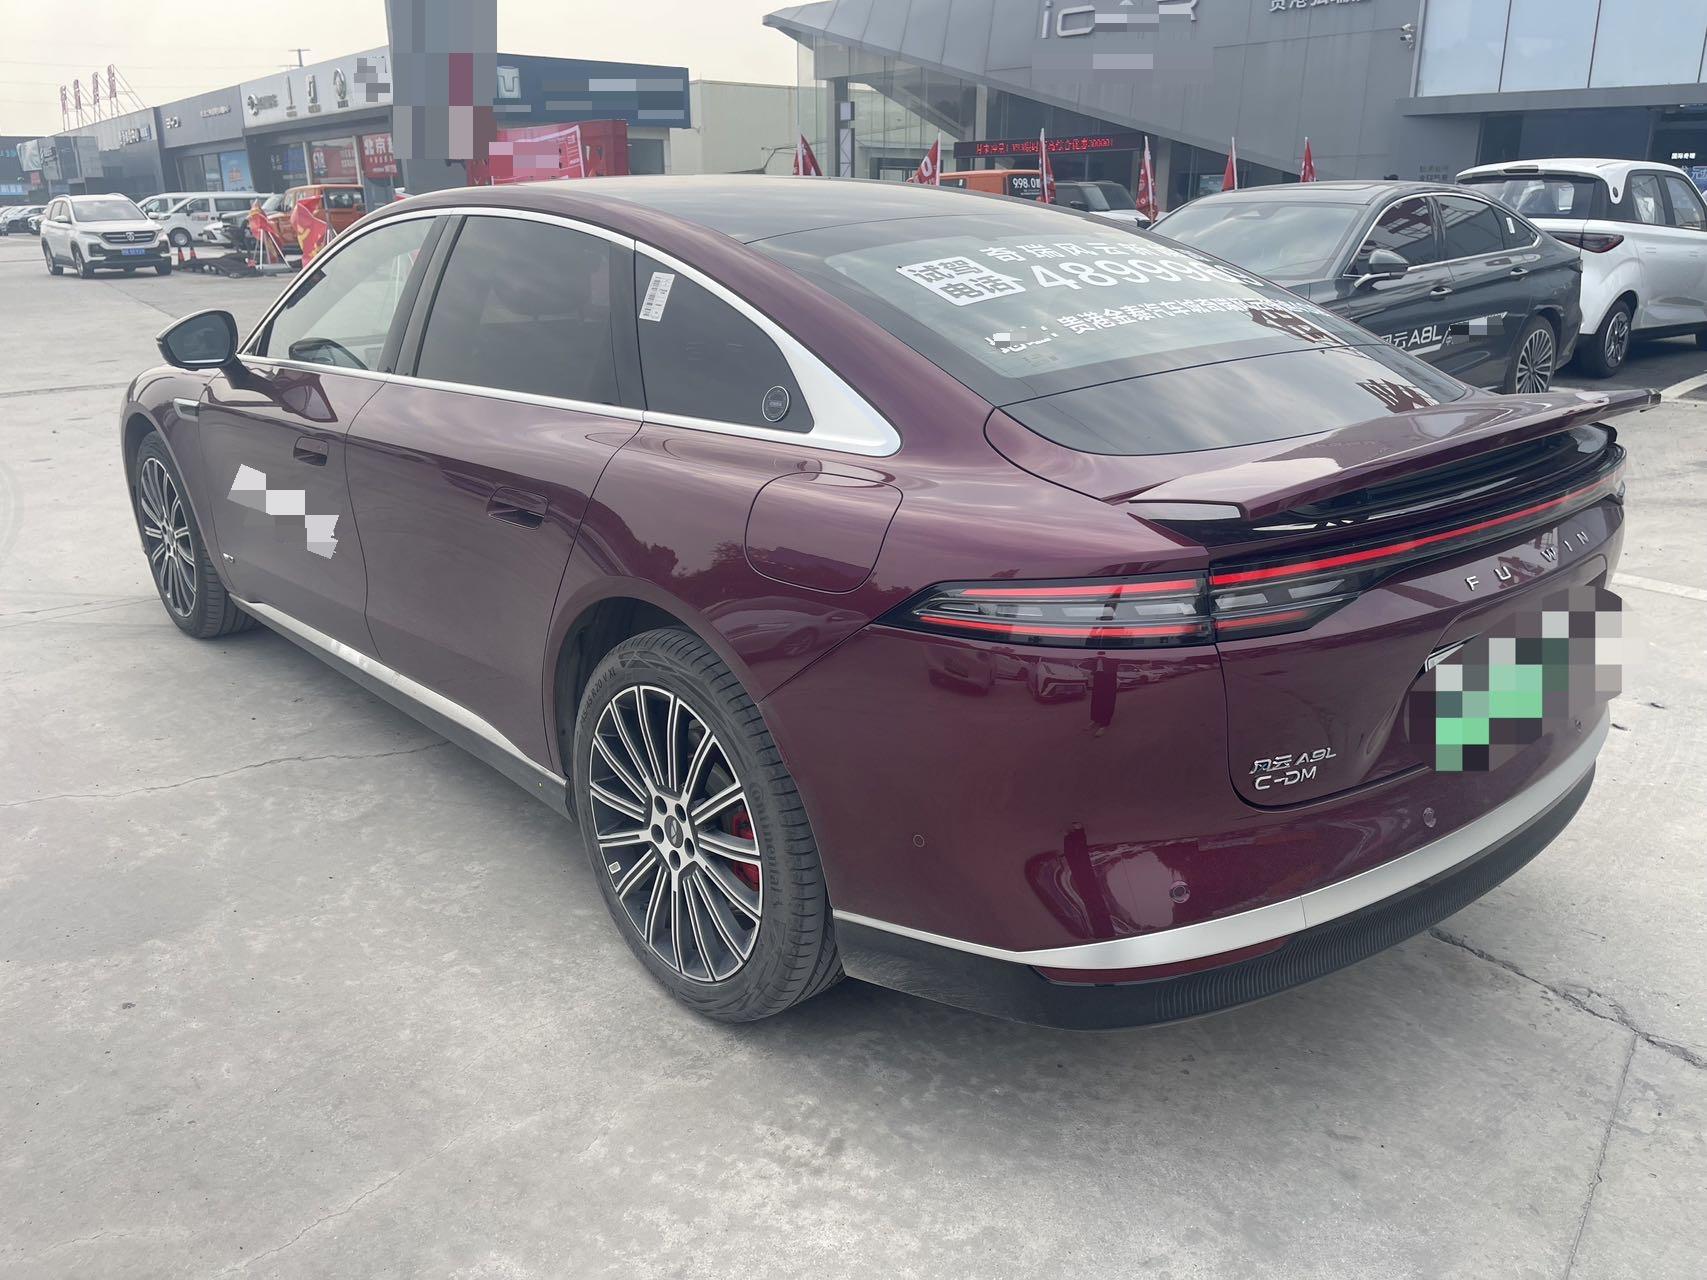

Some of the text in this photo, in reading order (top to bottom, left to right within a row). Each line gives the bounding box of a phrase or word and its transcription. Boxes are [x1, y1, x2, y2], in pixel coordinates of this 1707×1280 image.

[909, 259, 983, 283] 试驾
[1030, 258, 1264, 290] 4899969
[941, 275, 1015, 299] 电话
[1255, 766, 1317, 790] C-DM
